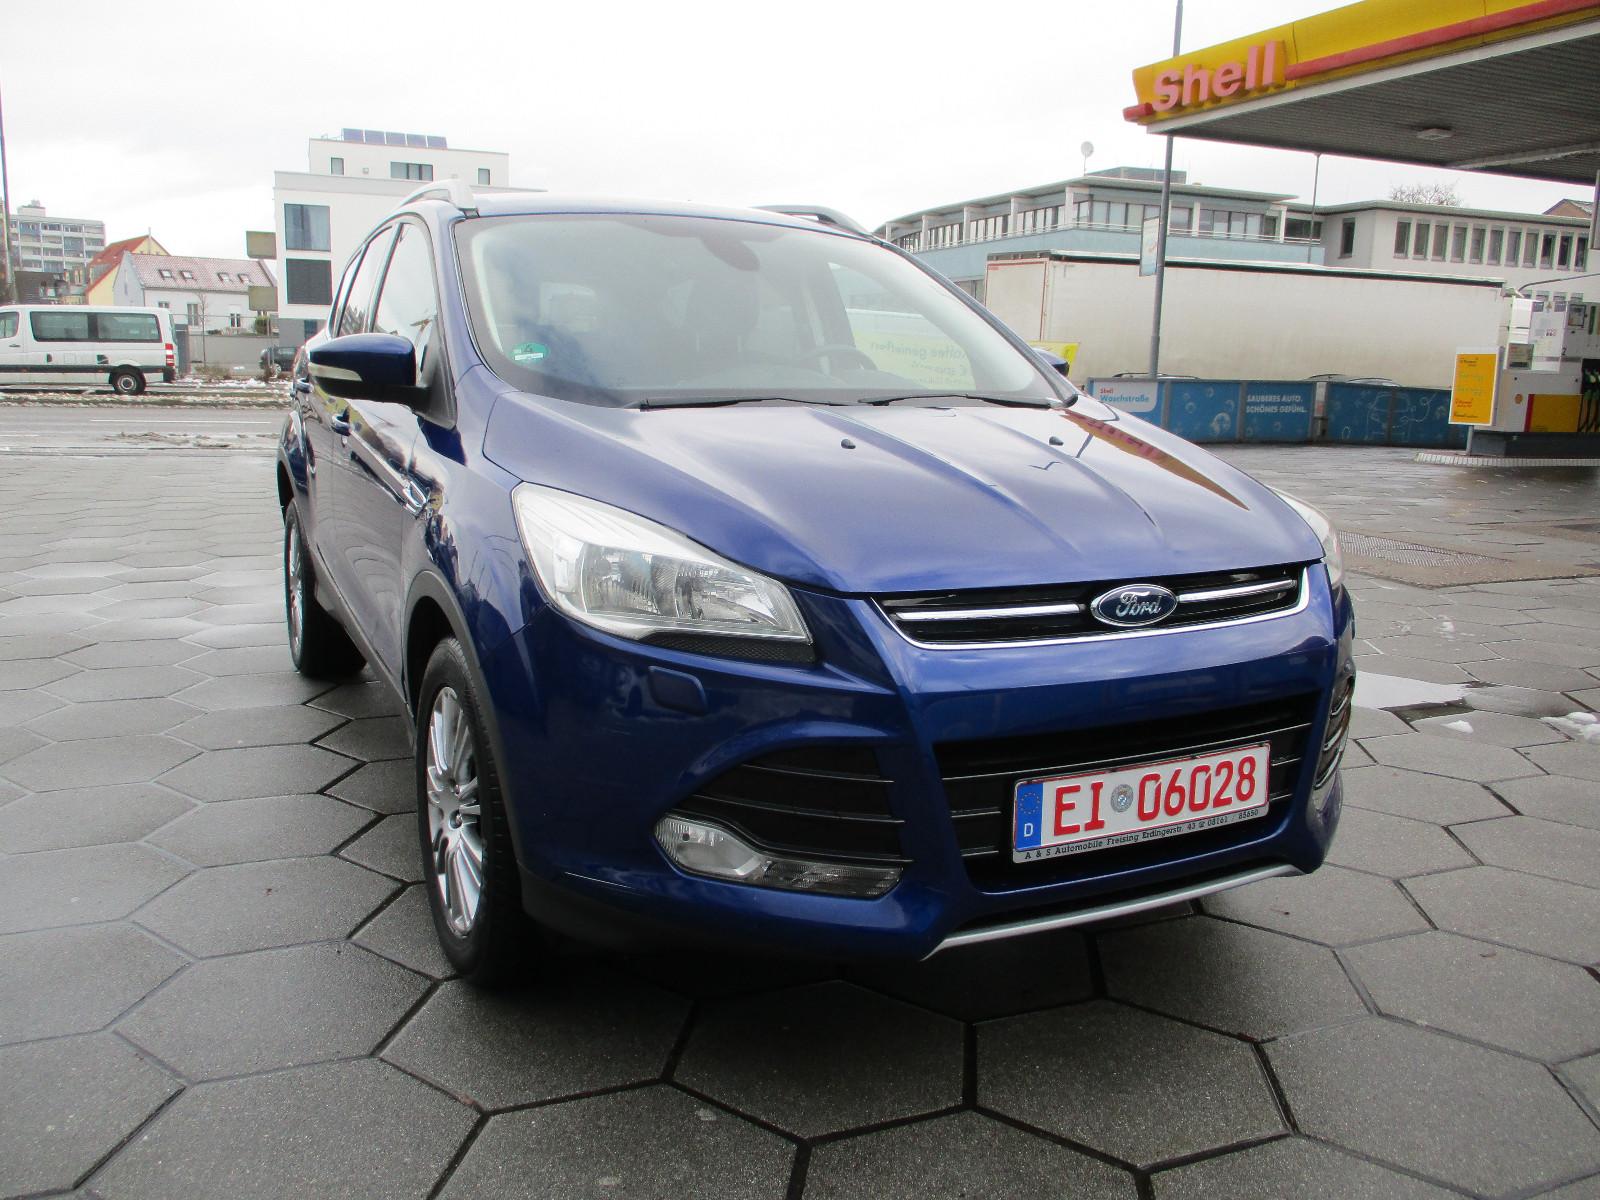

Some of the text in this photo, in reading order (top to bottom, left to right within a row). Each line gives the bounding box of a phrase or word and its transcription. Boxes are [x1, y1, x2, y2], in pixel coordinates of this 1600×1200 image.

[1151, 40, 1279, 112] Shell
[1099, 394, 1150, 402] Waschstraße
[1246, 403, 1279, 413] SCHÖNES
[1247, 394, 1280, 402] SAUBERES
[1115, 591, 1162, 617] Ford
[1054, 755, 1256, 837] EI 06028
[1023, 822, 1034, 837] D
[1024, 851, 1032, 860] A
[1036, 849, 1042, 857] &
[1046, 847, 1051, 856] S
[1055, 838, 1103, 855] Automobile
[1106, 832, 1140, 846] Freising
[1142, 825, 1184, 839] Erdingerstr.
